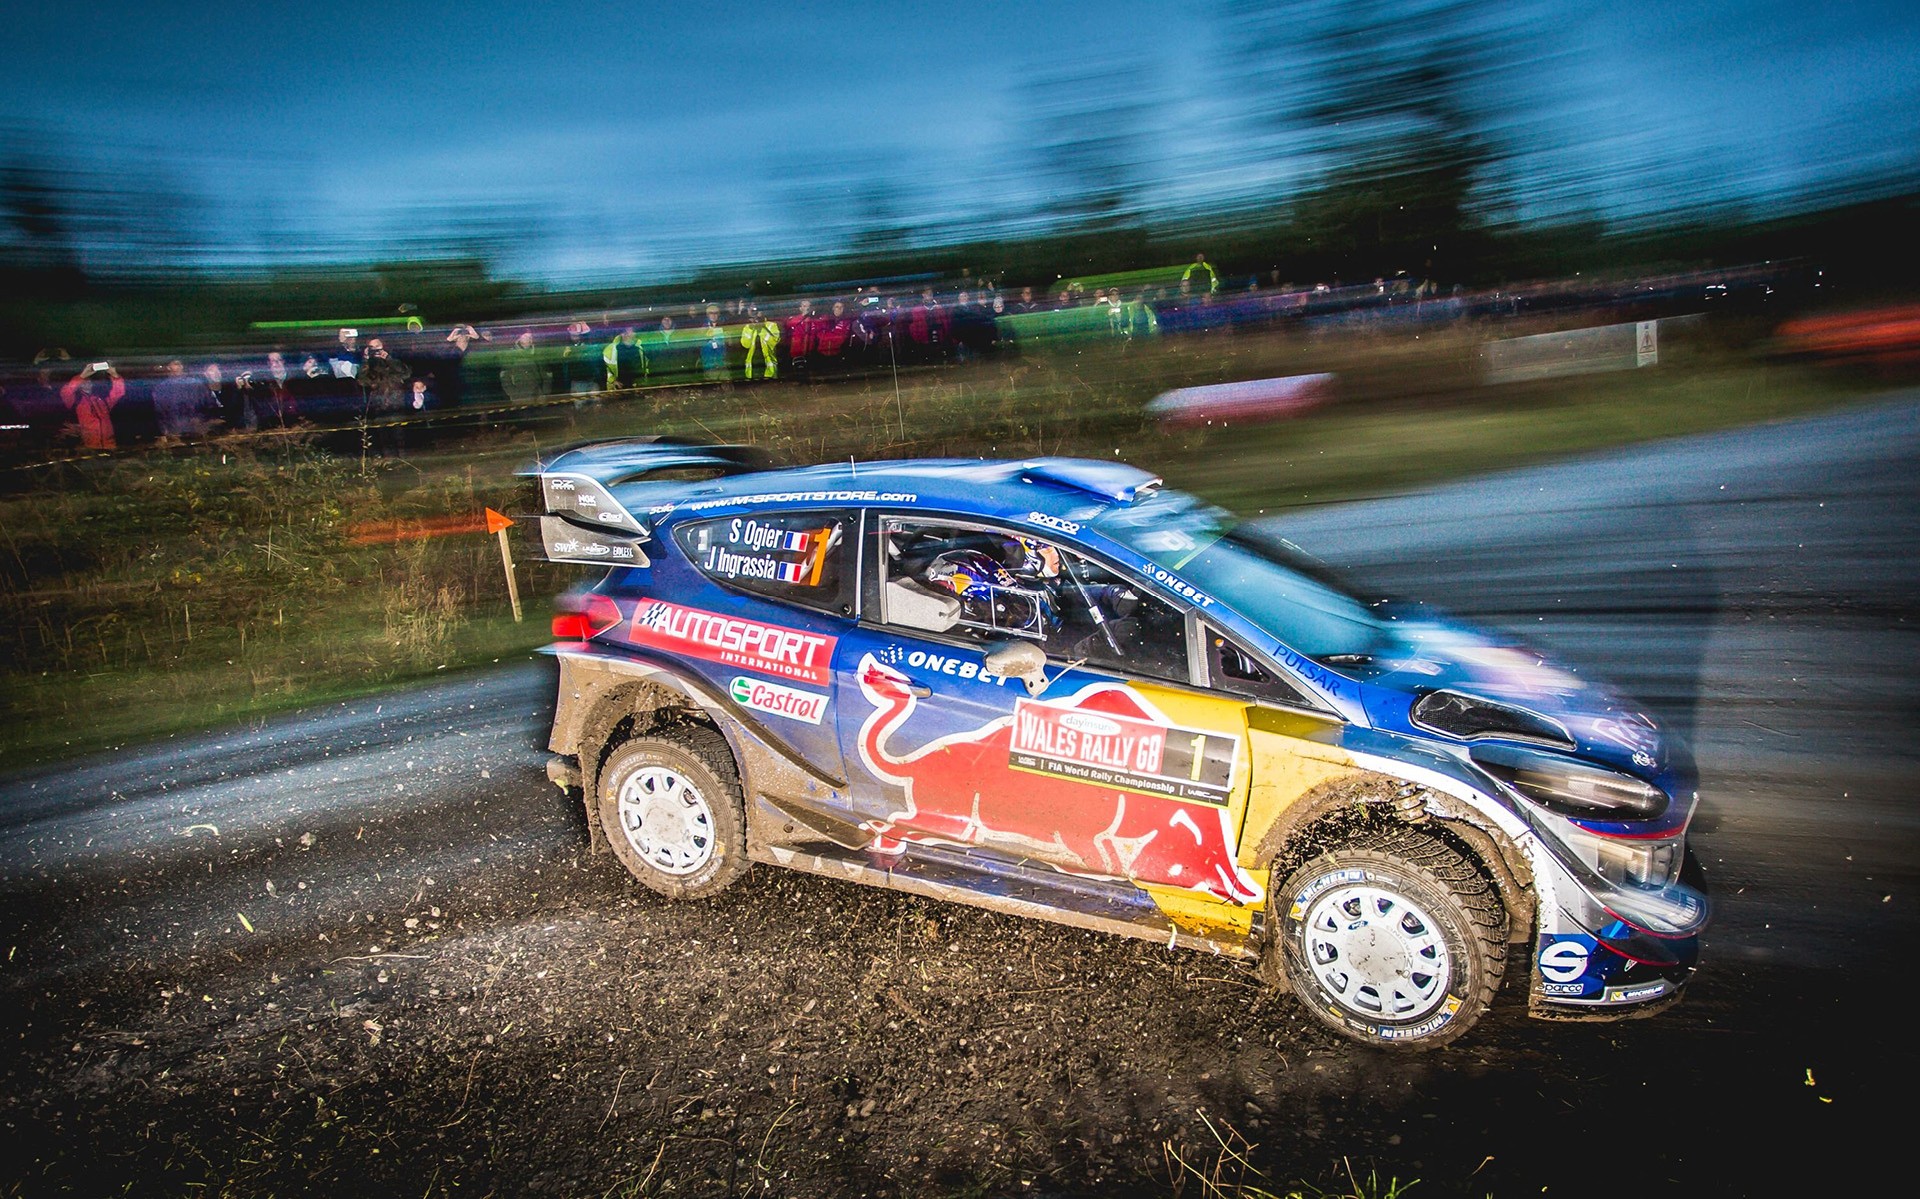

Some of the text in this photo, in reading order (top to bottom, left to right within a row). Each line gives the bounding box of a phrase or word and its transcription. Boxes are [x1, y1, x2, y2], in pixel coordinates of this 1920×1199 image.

[691, 490, 918, 511] www.M-SPORTSTORE.com
[729, 518, 784, 551] S Ogier
[1027, 511, 1080, 534] sparco
[704, 545, 777, 579] J Ingrassia
[810, 527, 832, 587] 1
[1155, 570, 1215, 608] ONEBET
[652, 603, 827, 668] AUTOSPORT
[720, 651, 819, 681] INTERNATIONAL
[1272, 645, 1341, 697] PULSAR
[752, 684, 820, 720] Castrol
[1020, 708, 1163, 773] WALES RALLY GB
[1190, 734, 1207, 782] 1
[1048, 761, 1062, 772] FIA
[1064, 764, 1089, 777] World
[1091, 770, 1113, 783] Rally
[1114, 774, 1176, 794] Championship
[1626, 985, 1665, 998] MICHELIN
[1380, 1014, 1445, 1038] MICHELIN
